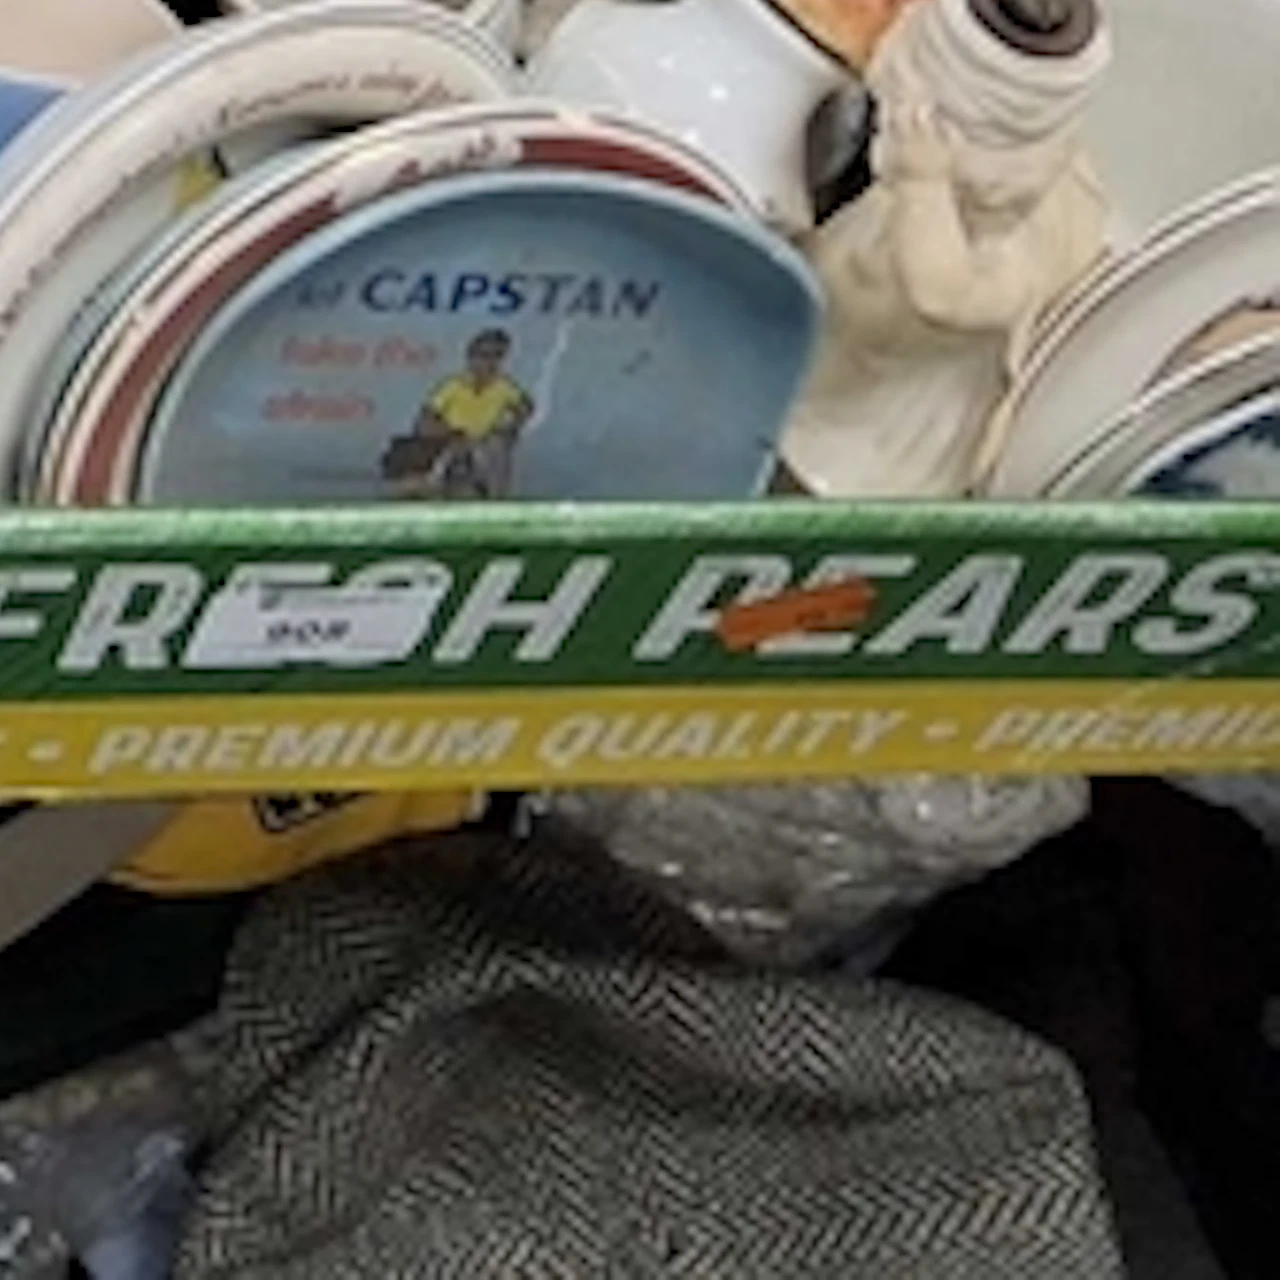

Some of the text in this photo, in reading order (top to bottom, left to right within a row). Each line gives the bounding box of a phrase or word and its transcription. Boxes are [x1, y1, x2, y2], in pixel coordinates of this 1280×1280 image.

[360, 270, 659, 318] CAPSTAN
[87, 715, 522, 776] PREMIUM
[537, 708, 909, 770] QUALITY
